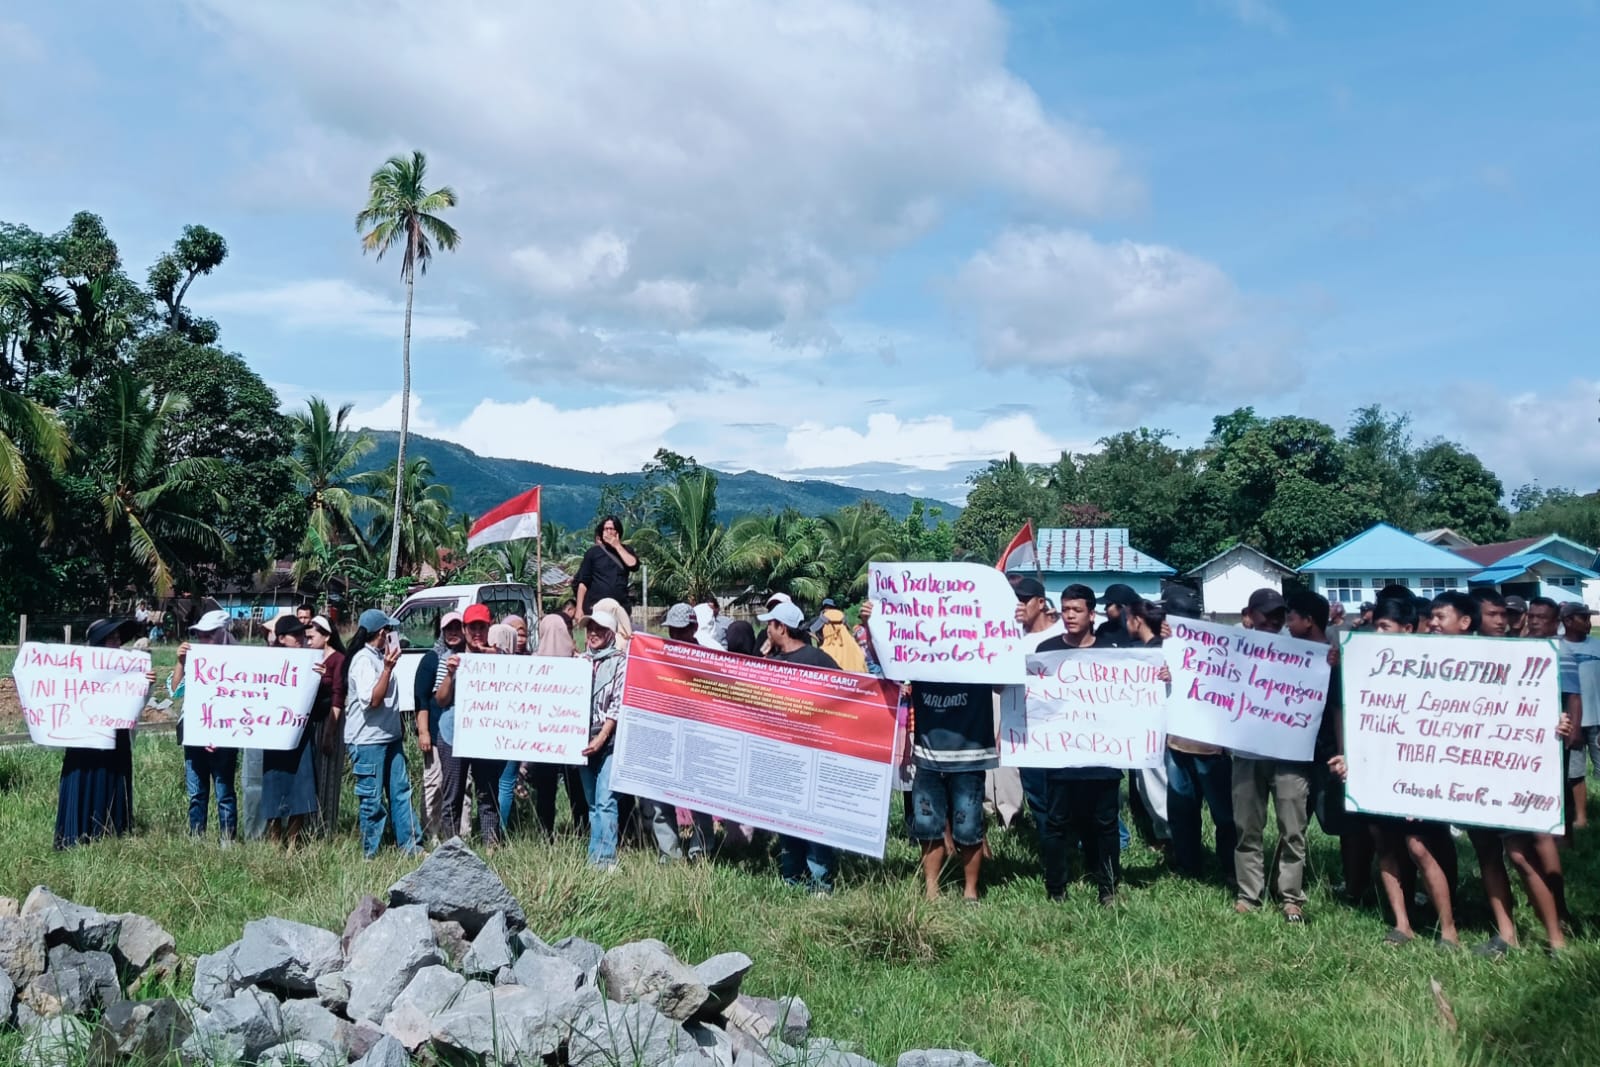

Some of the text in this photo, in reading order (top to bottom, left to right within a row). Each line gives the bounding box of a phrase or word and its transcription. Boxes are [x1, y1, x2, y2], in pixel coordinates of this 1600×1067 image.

[875, 569, 898, 593] Pak
[880, 597, 934, 618] Bantu
[1176, 623, 1230, 657] Orang
[461, 659, 496, 675] KAMI
[662, 643, 690, 654] FORUM
[690, 649, 738, 664] PENYELAMAT
[768, 663, 797, 675] ULAYAT
[798, 669, 828, 681] TABEAK
[1517, 656, 1552, 687] !!!
[31, 679, 55, 698] INI
[64, 678, 120, 704] HARGA
[1360, 689, 1409, 714] TANAH
[463, 699, 499, 713] TANAH
[508, 700, 541, 716] KAMI
[1416, 718, 1484, 740] ULAYAT
[1488, 724, 1545, 744] DESA
[1397, 742, 1543, 773] TABA SEBERANG
